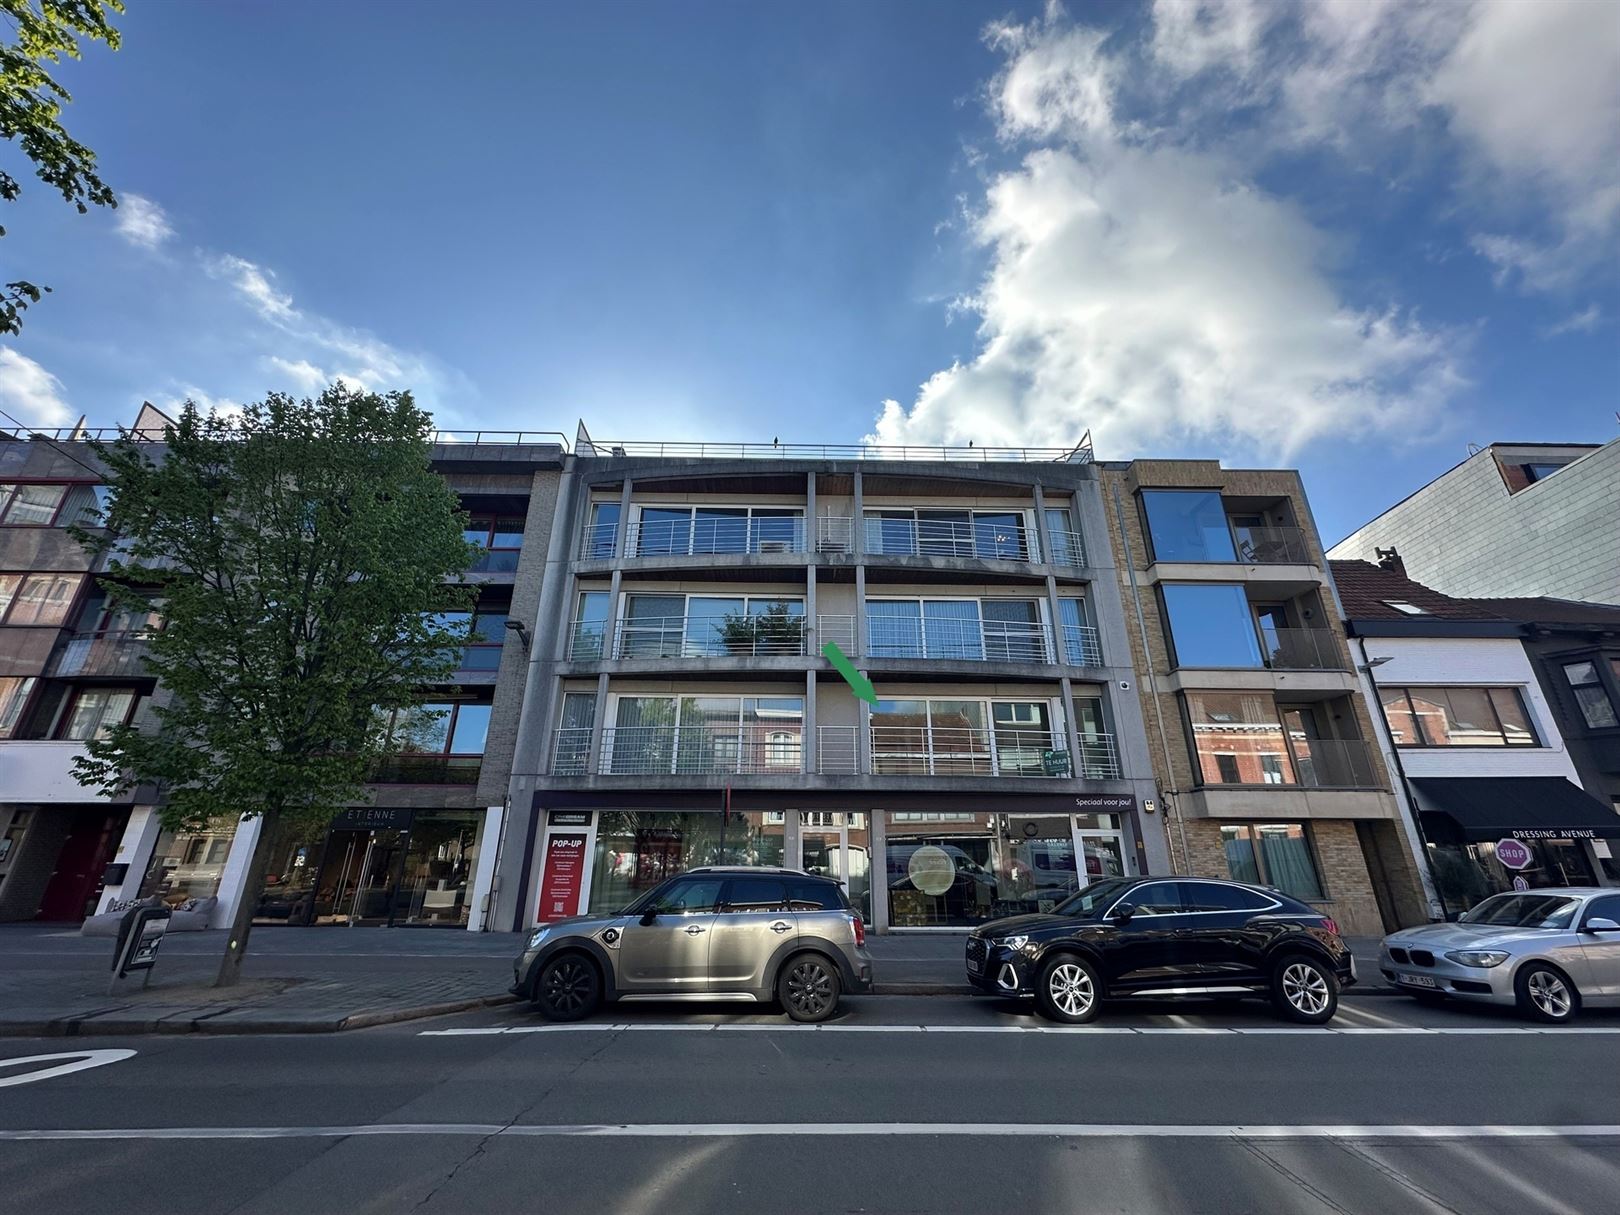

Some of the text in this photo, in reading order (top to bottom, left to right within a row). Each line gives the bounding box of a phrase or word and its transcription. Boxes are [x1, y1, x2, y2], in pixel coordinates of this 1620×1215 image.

[1075, 798, 1103, 807] Speciaal
[1118, 798, 1132, 807] jou!
[347, 809, 396, 820] ETIENNE
[1512, 829, 1596, 839] DRESSING AVENUE
[551, 839, 583, 848] POP-UP
[1499, 847, 1525, 859] SHOP
